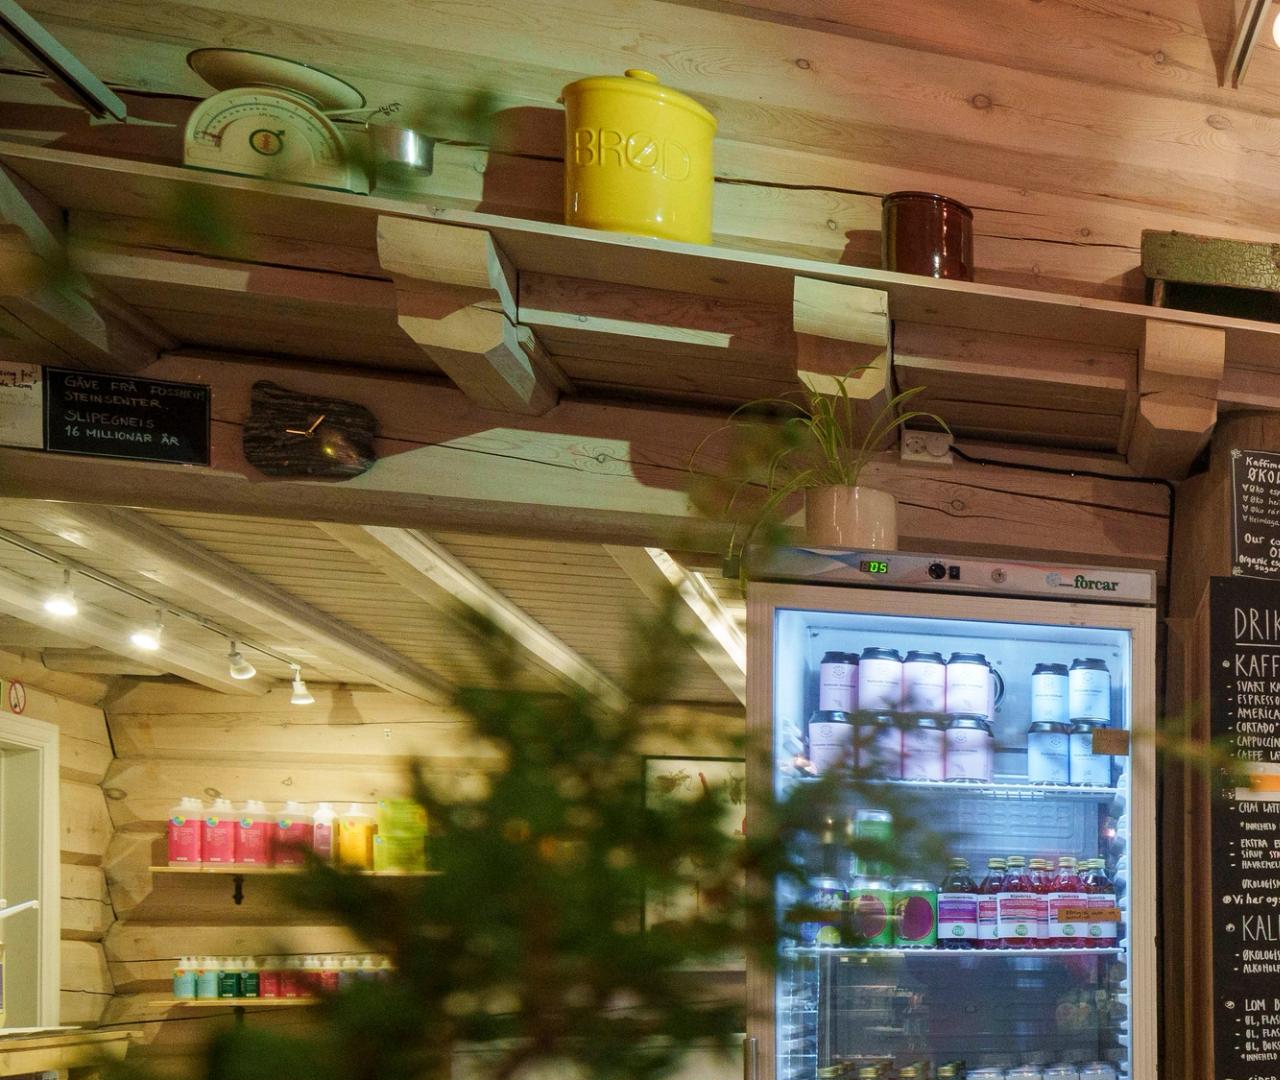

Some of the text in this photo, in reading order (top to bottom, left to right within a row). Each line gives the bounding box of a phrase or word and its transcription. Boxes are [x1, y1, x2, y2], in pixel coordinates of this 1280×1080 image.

[575, 128, 690, 182] BRØD
[64, 376, 100, 390] GÅVE
[110, 381, 138, 393] FRÅ
[64, 409, 155, 429] SLIPEGNEIS
[65, 425, 80, 437] 16
[161, 432, 180, 446] ÅR
[1244, 533, 1265, 544] Our
[1074, 575, 1119, 592] forcar
[1237, 680, 1265, 692] SVART
[1237, 694, 1280, 706] ESPRESSO
[1238, 802, 1258, 813] CHAI
[1232, 894, 1244, 904] Vi
[1245, 998, 1266, 1011] LOM
